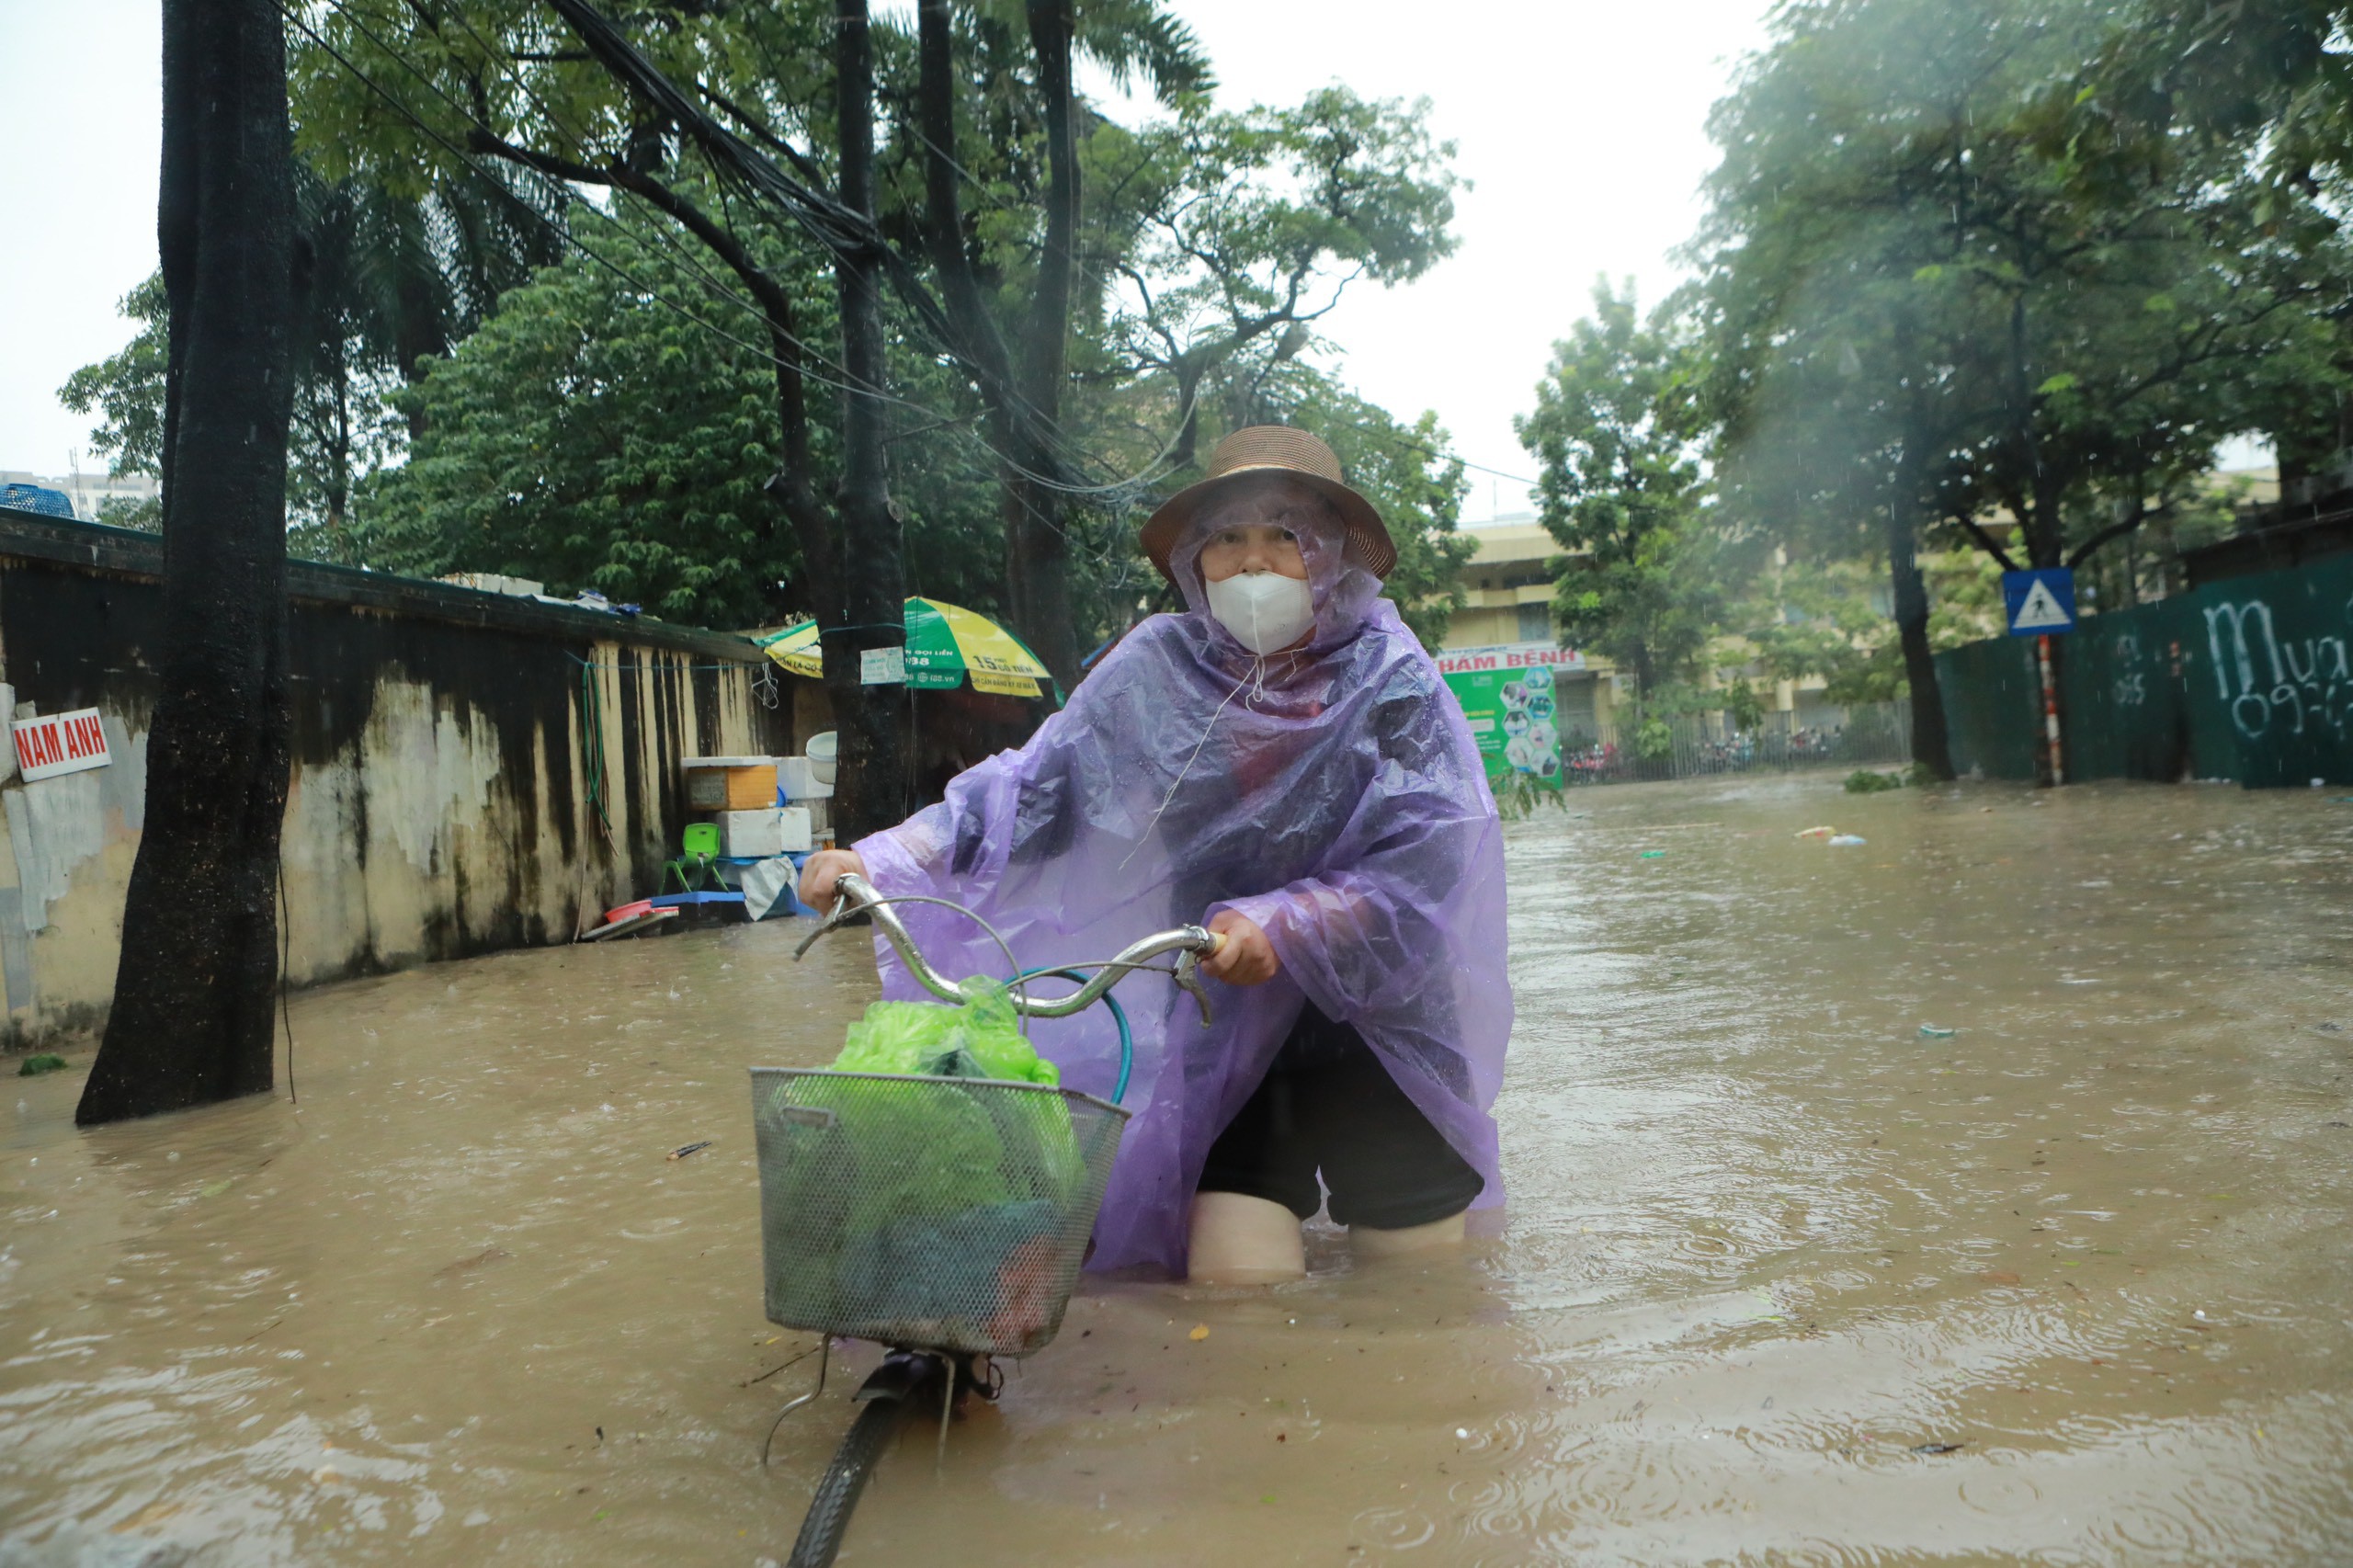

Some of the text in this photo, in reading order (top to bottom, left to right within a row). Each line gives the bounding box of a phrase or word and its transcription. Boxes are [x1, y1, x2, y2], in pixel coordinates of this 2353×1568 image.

[972, 654, 998, 670] 15
[1437, 653, 1496, 674] HÁM
[14, 715, 107, 769] NAM ANH
